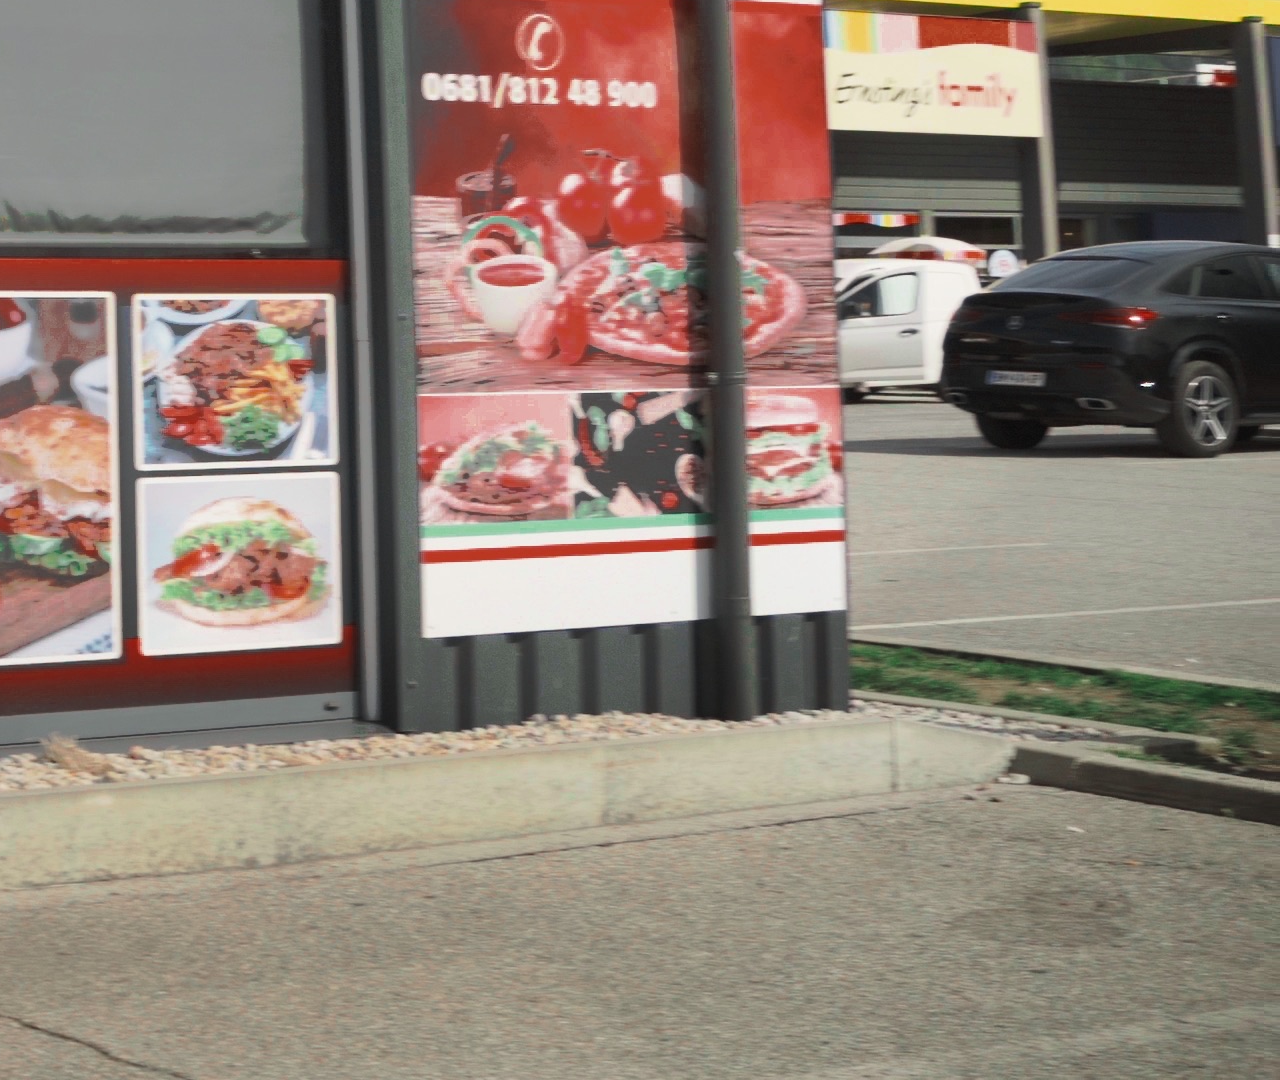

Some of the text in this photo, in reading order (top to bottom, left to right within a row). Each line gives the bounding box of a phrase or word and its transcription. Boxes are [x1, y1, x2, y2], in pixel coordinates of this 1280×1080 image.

[421, 72, 658, 109] 0681/812 48 900
[937, 71, 1018, 117] family
